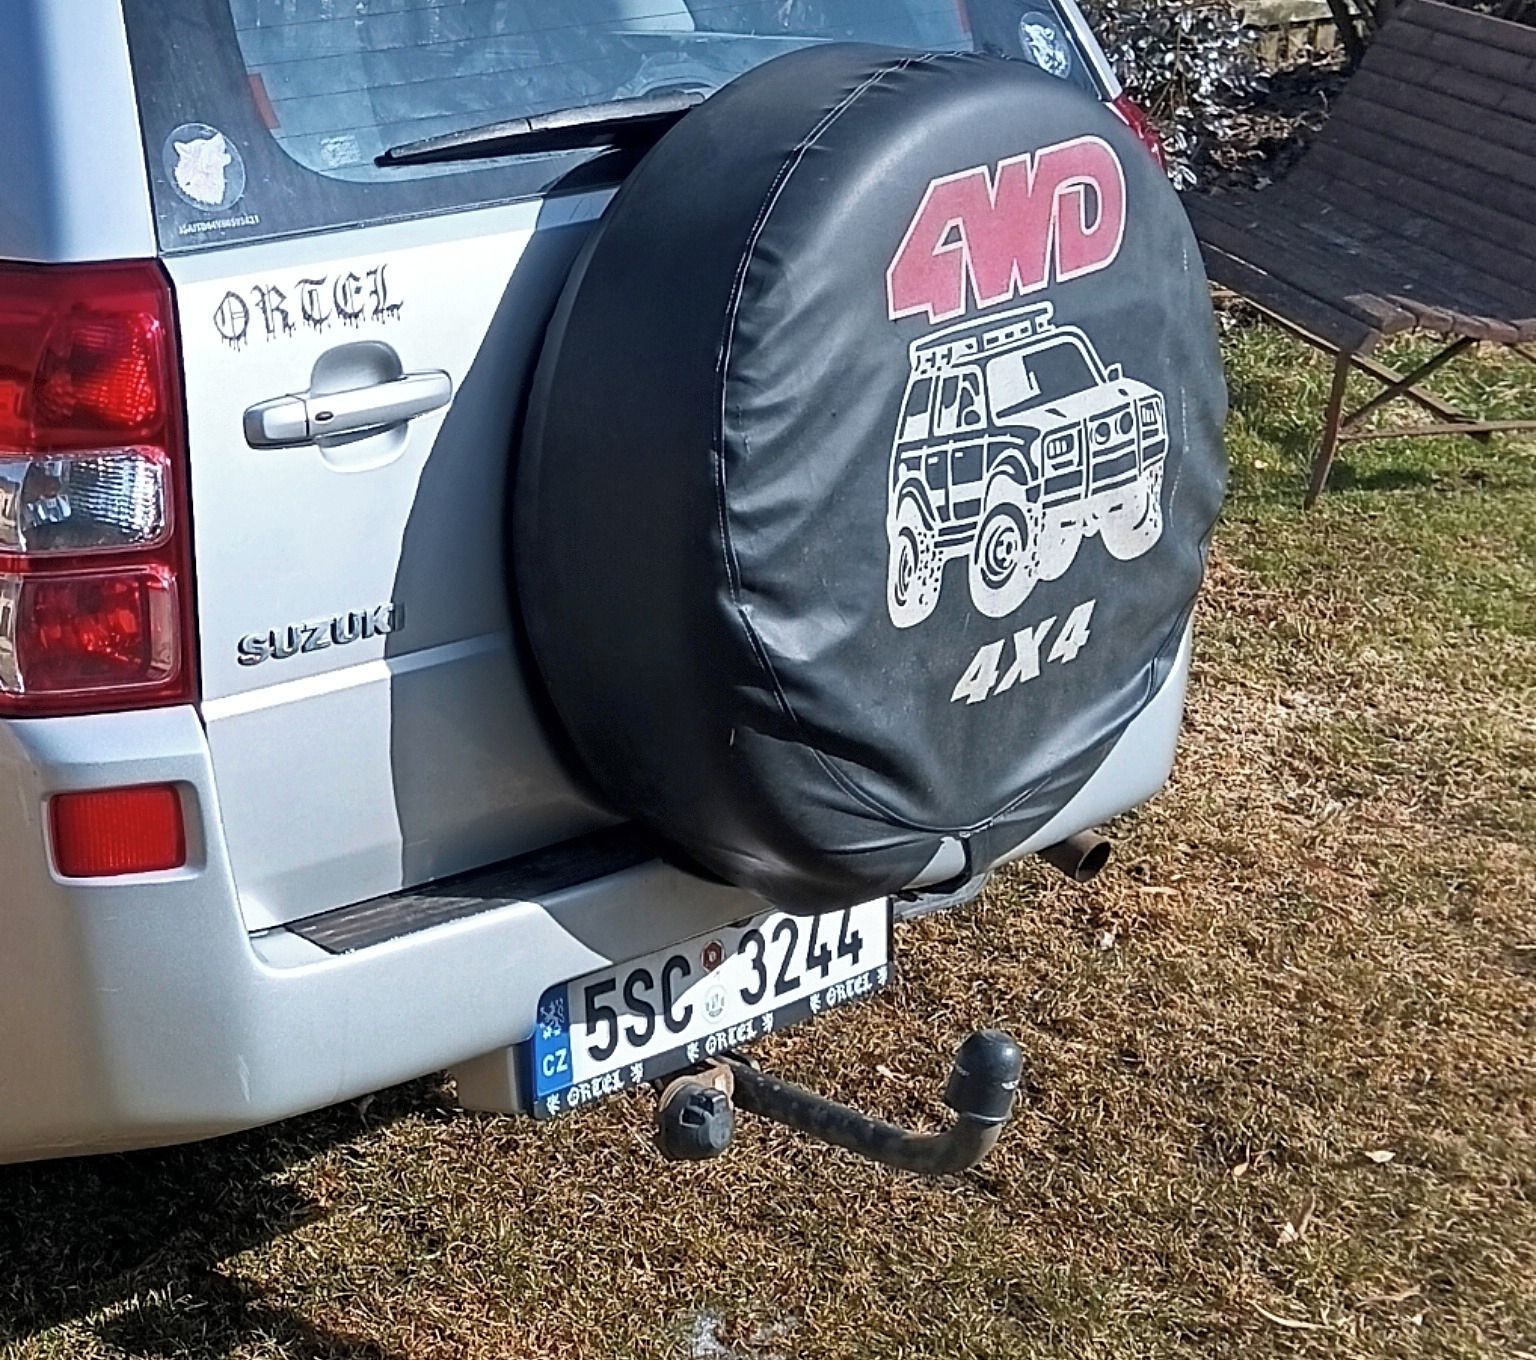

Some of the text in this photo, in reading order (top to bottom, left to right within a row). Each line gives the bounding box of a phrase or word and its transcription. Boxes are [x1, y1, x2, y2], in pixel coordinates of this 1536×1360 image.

[885, 134, 1126, 324] 4WD
[237, 602, 405, 666] SUZUKI
[584, 908, 863, 1061] 5SC 3244
[543, 1048, 568, 1077] CZ
